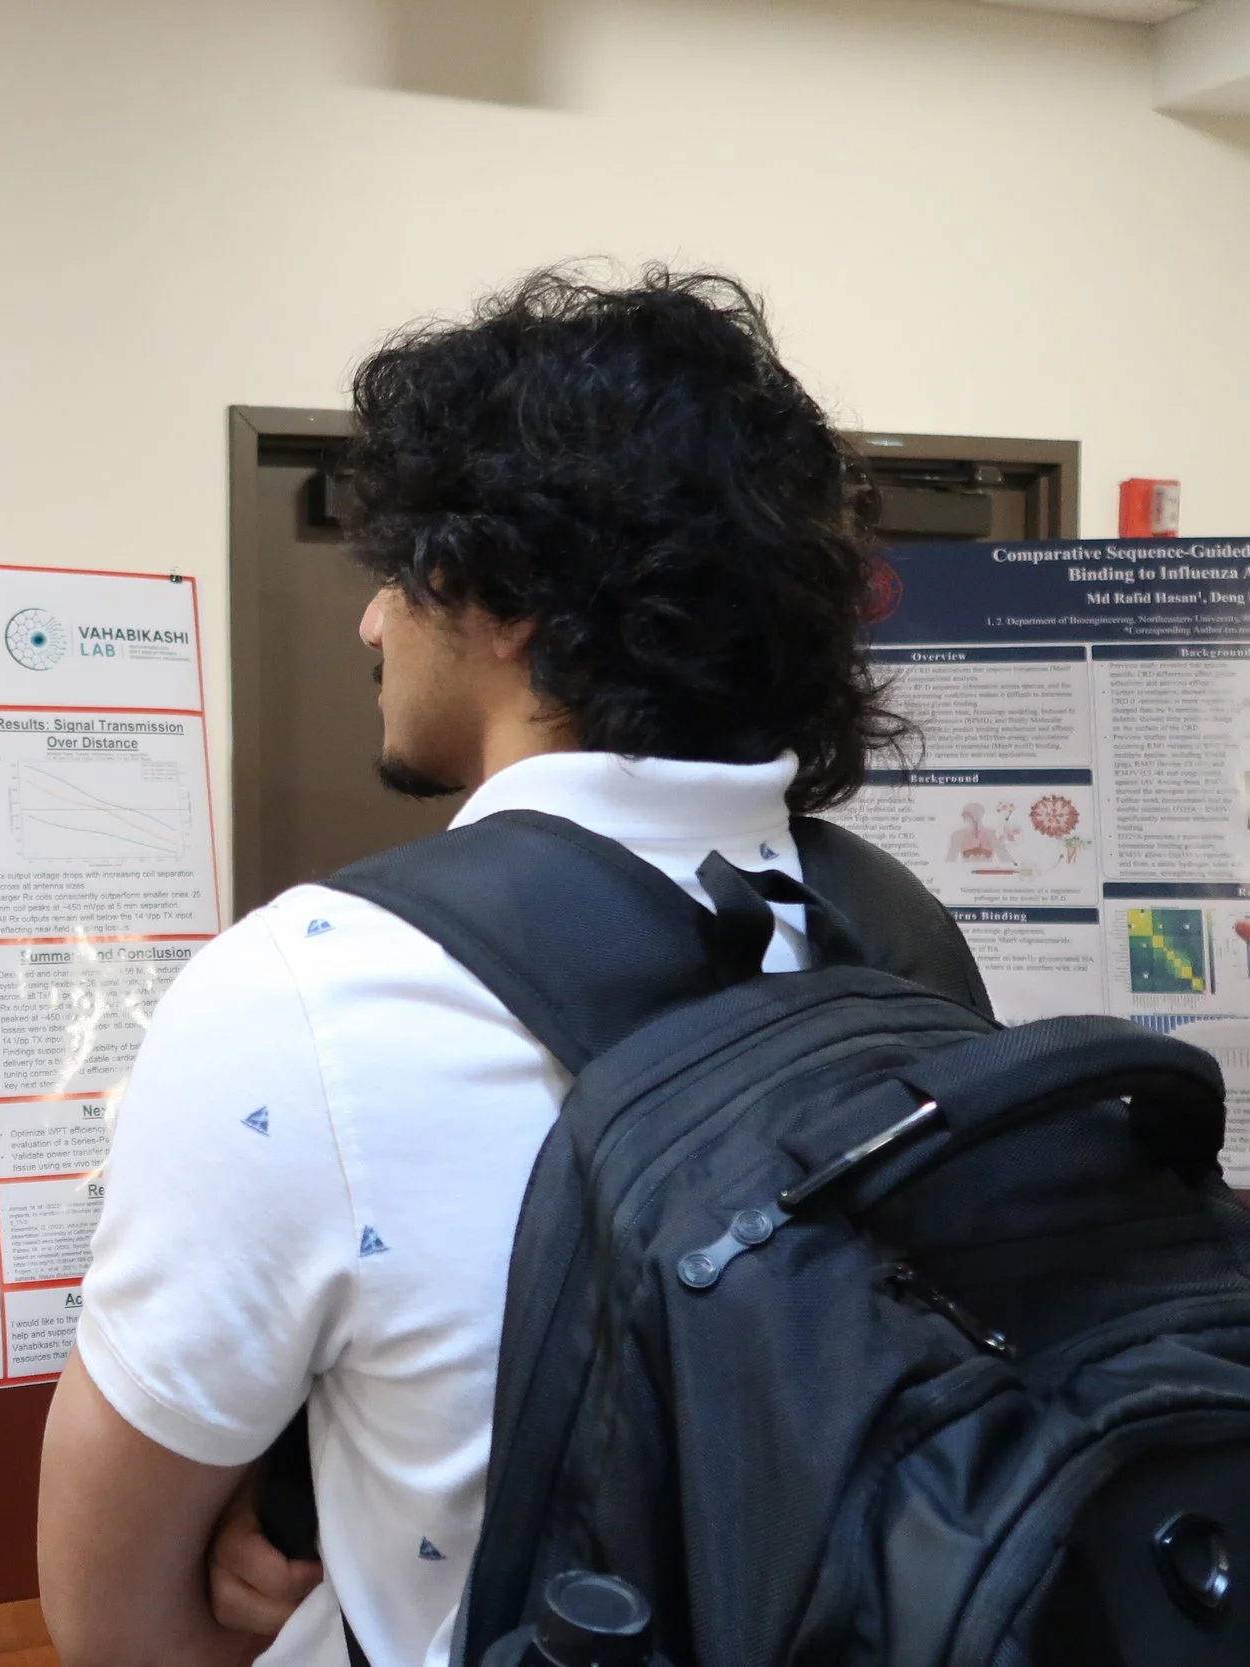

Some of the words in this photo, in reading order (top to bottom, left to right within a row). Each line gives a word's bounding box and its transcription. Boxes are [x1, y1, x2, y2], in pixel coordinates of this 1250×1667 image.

[991, 546, 1102, 564] Comparative
[1067, 567, 1135, 583] Binding
[1137, 567, 1156, 580] to
[1159, 566, 1238, 579] Influenza
[1087, 592, 1110, 604] Md
[1113, 591, 1151, 604] Rafid
[1210, 590, 1244, 604] Deng
[77, 626, 189, 644] VAHABIKASHI
[79, 642, 116, 657] LAB
[910, 652, 966, 660] Overview
[53, 718, 94, 732] Signal
[98, 719, 183, 732] Transmission
[46, 735, 78, 749] Over
[81, 736, 139, 749] Distance
[909, 774, 979, 784] Background
[953, 911, 977, 920] irus
[980, 910, 1027, 922] Binding
